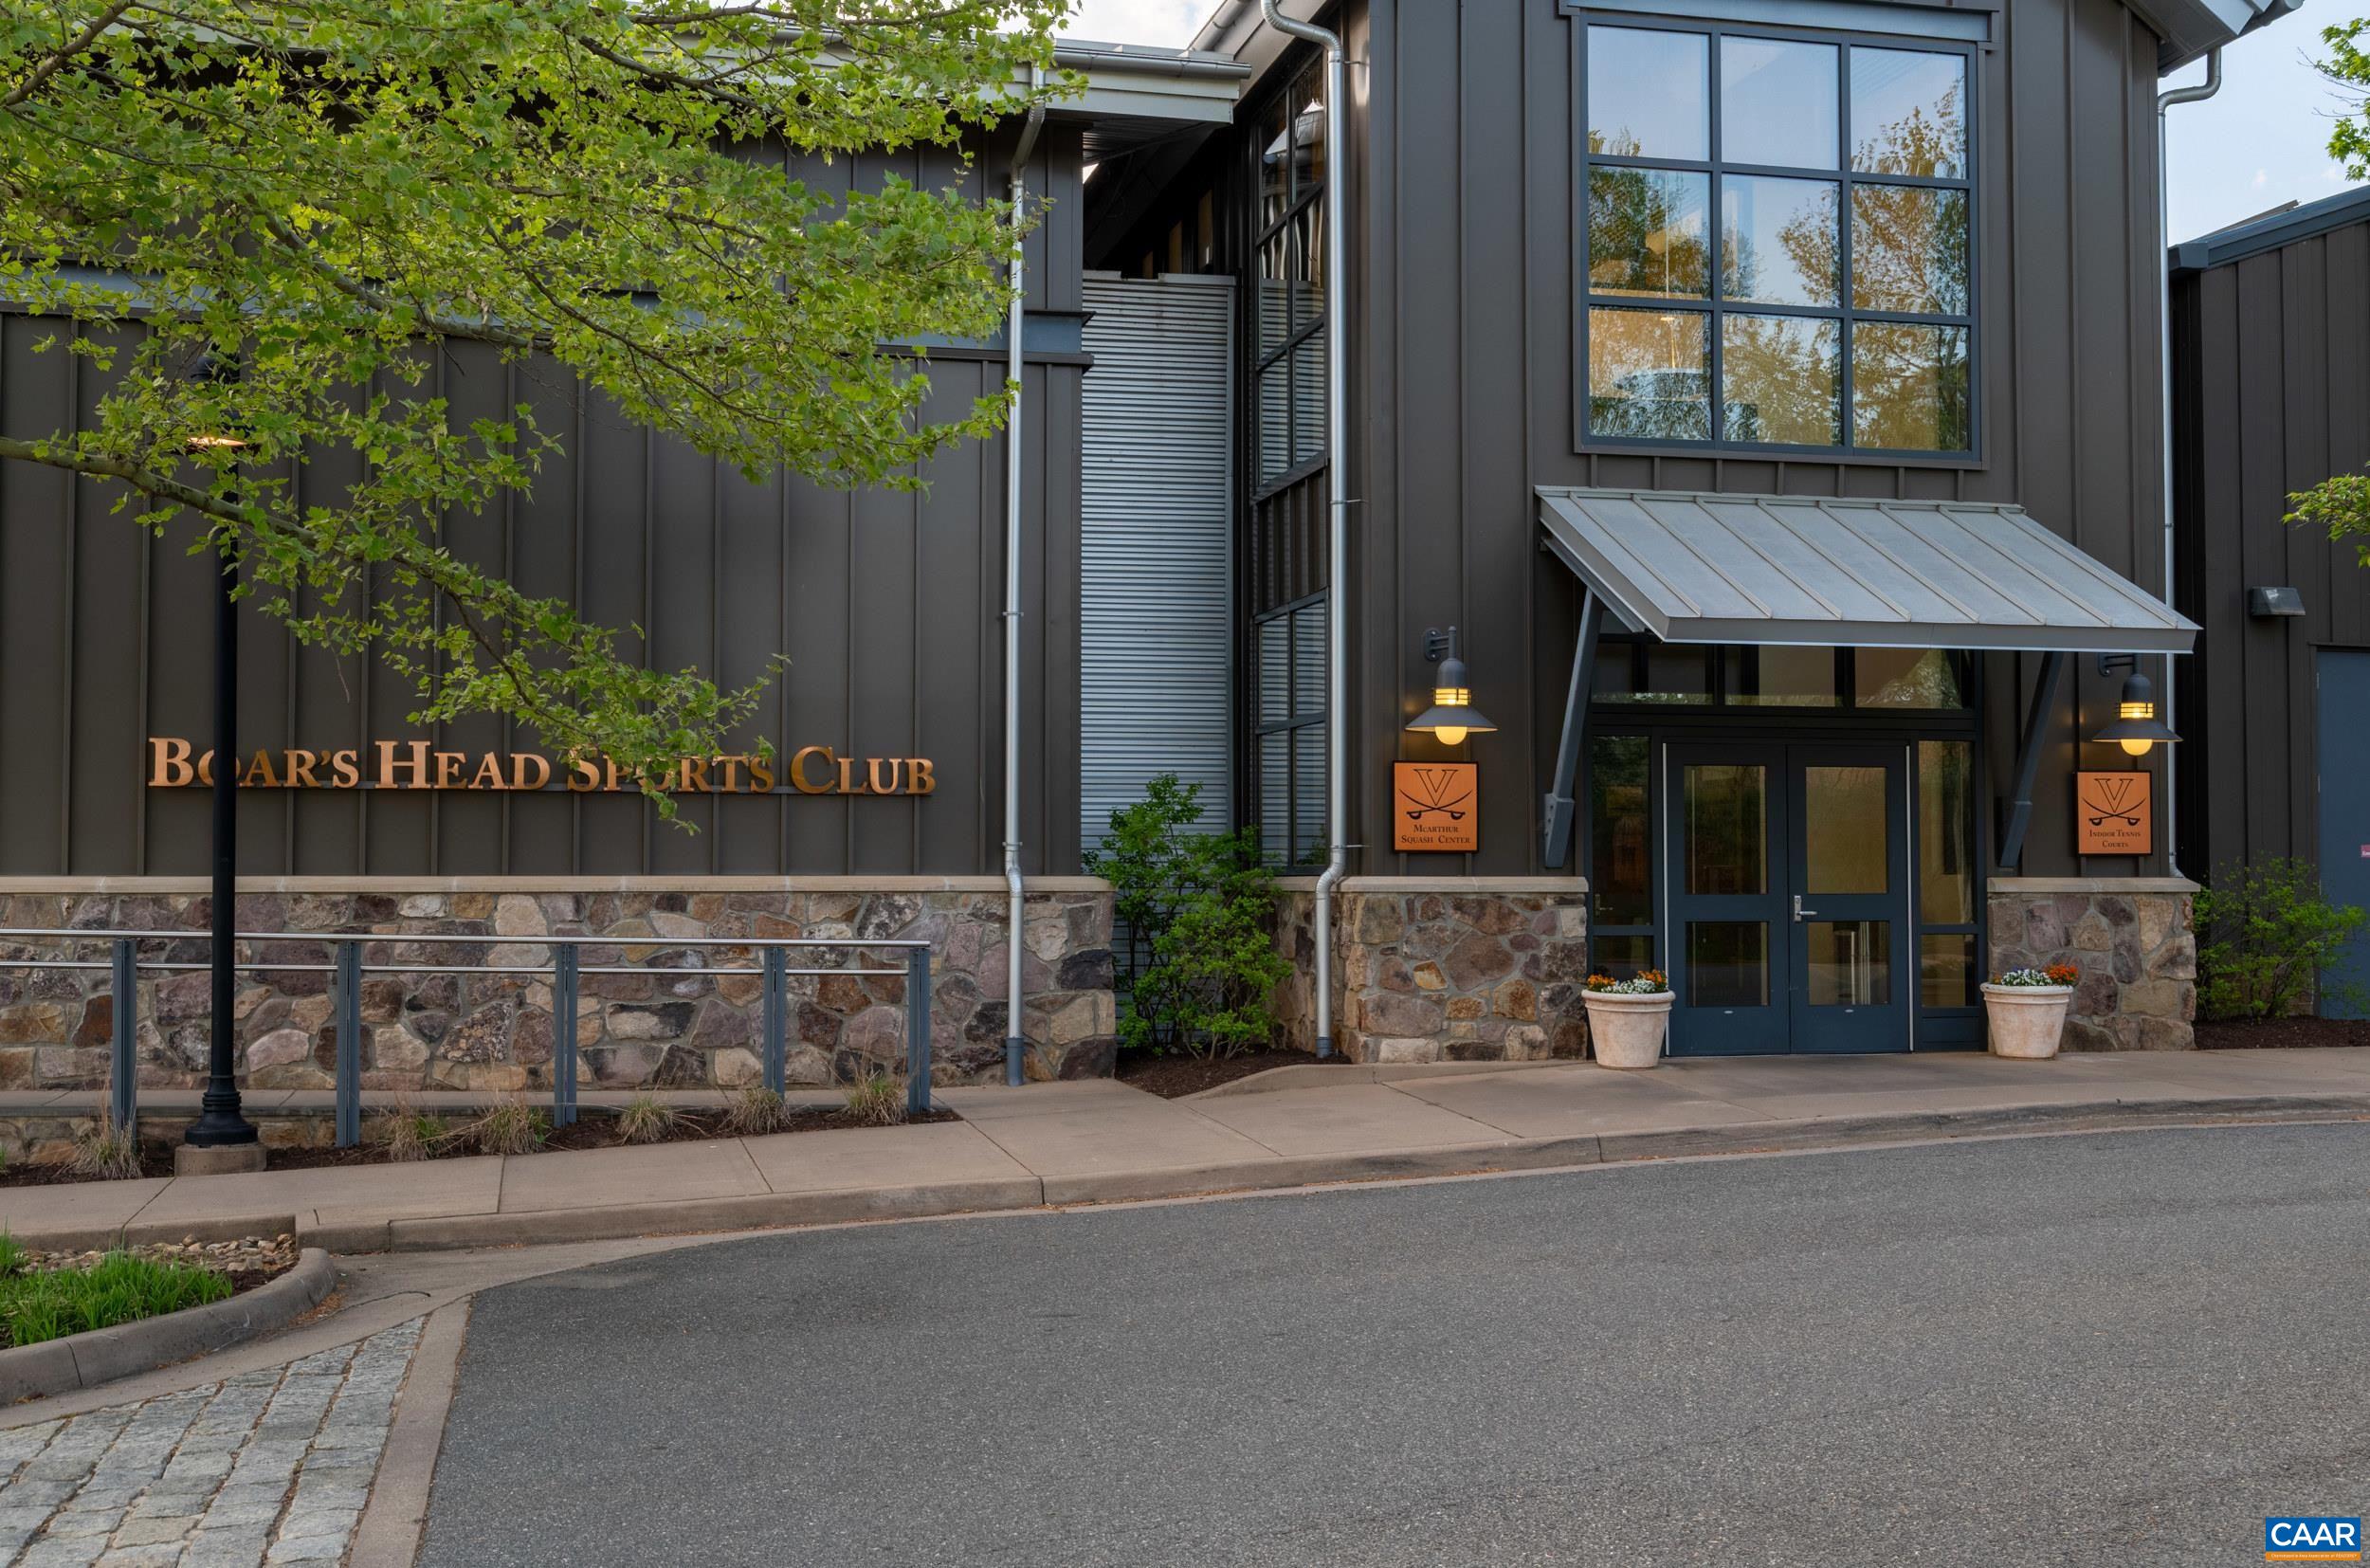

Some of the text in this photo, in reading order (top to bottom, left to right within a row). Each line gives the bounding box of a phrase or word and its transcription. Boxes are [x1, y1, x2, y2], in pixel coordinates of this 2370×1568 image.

[374, 740, 551, 791] HEAD
[791, 745, 937, 794] CLUB
[1401, 834, 1471, 845] SQUASH CENTER
